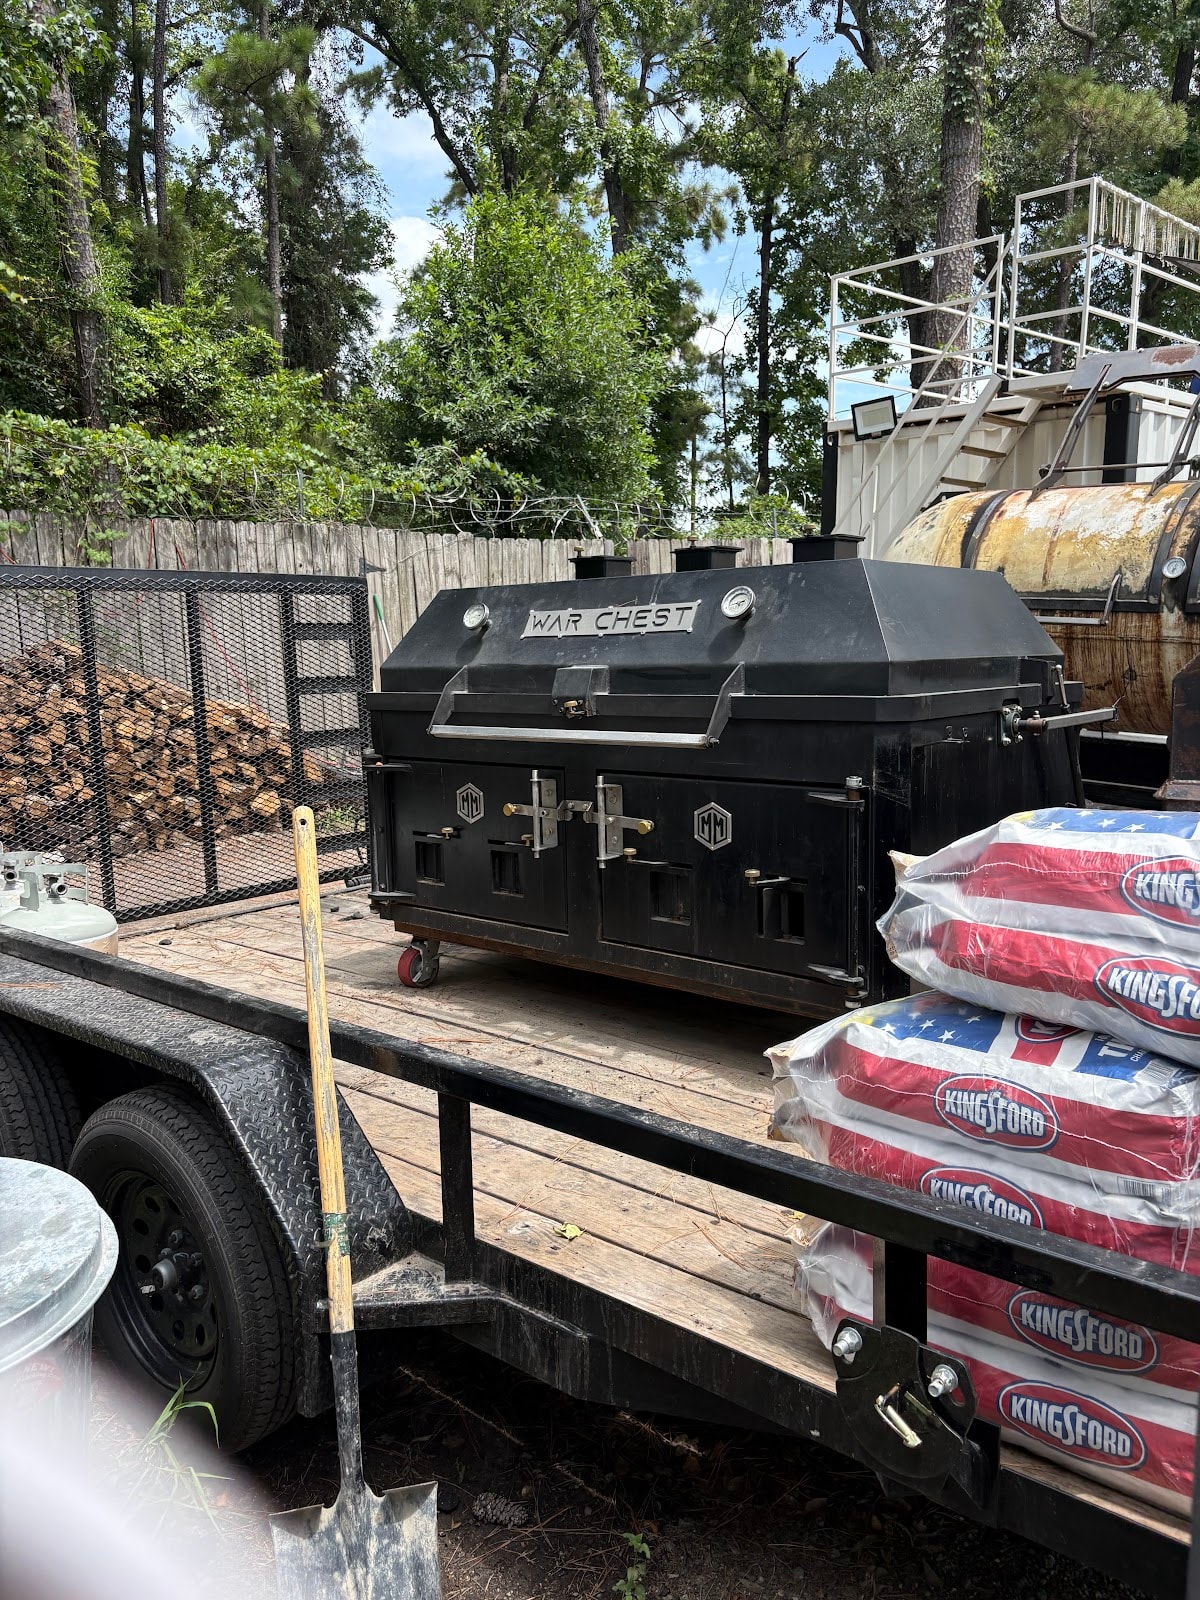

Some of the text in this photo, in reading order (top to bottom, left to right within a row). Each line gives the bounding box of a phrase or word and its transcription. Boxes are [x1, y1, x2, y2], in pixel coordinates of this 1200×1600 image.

[532, 606, 693, 632] WAR CHEST
[944, 1089, 1045, 1137] KINGSFORD
[1021, 1302, 1143, 1359] KINGSFORD
[1011, 1395, 1132, 1457] KINGSFORD
